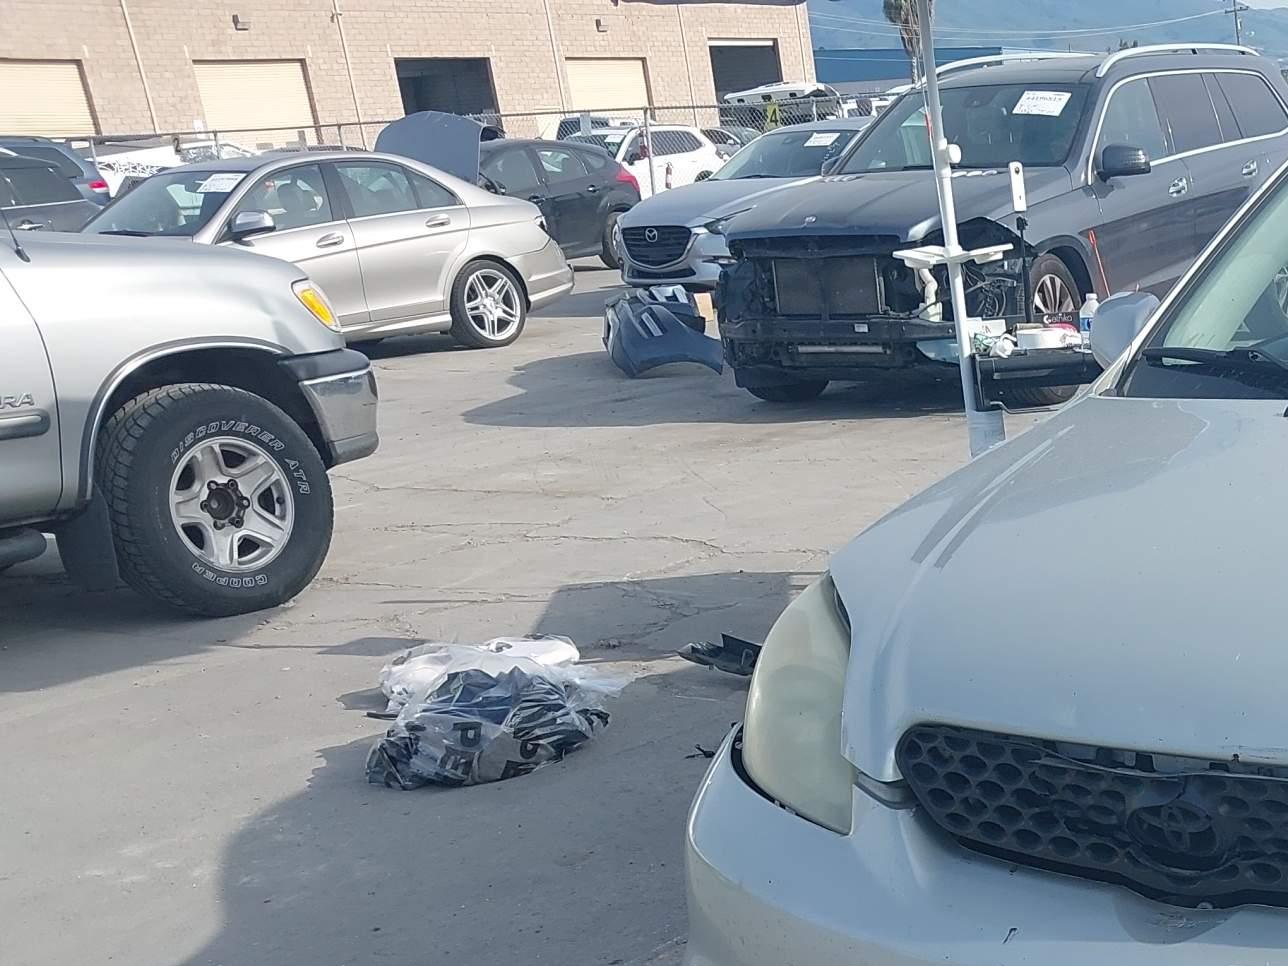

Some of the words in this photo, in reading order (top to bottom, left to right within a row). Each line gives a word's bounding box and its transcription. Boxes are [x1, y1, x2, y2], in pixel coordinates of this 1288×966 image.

[769, 107, 779, 126] 4
[0, 393, 35, 409] RA
[171, 420, 285, 464] DISCOVERER
[285, 457, 310, 495] ATR
[192, 562, 268, 587] COOPER
